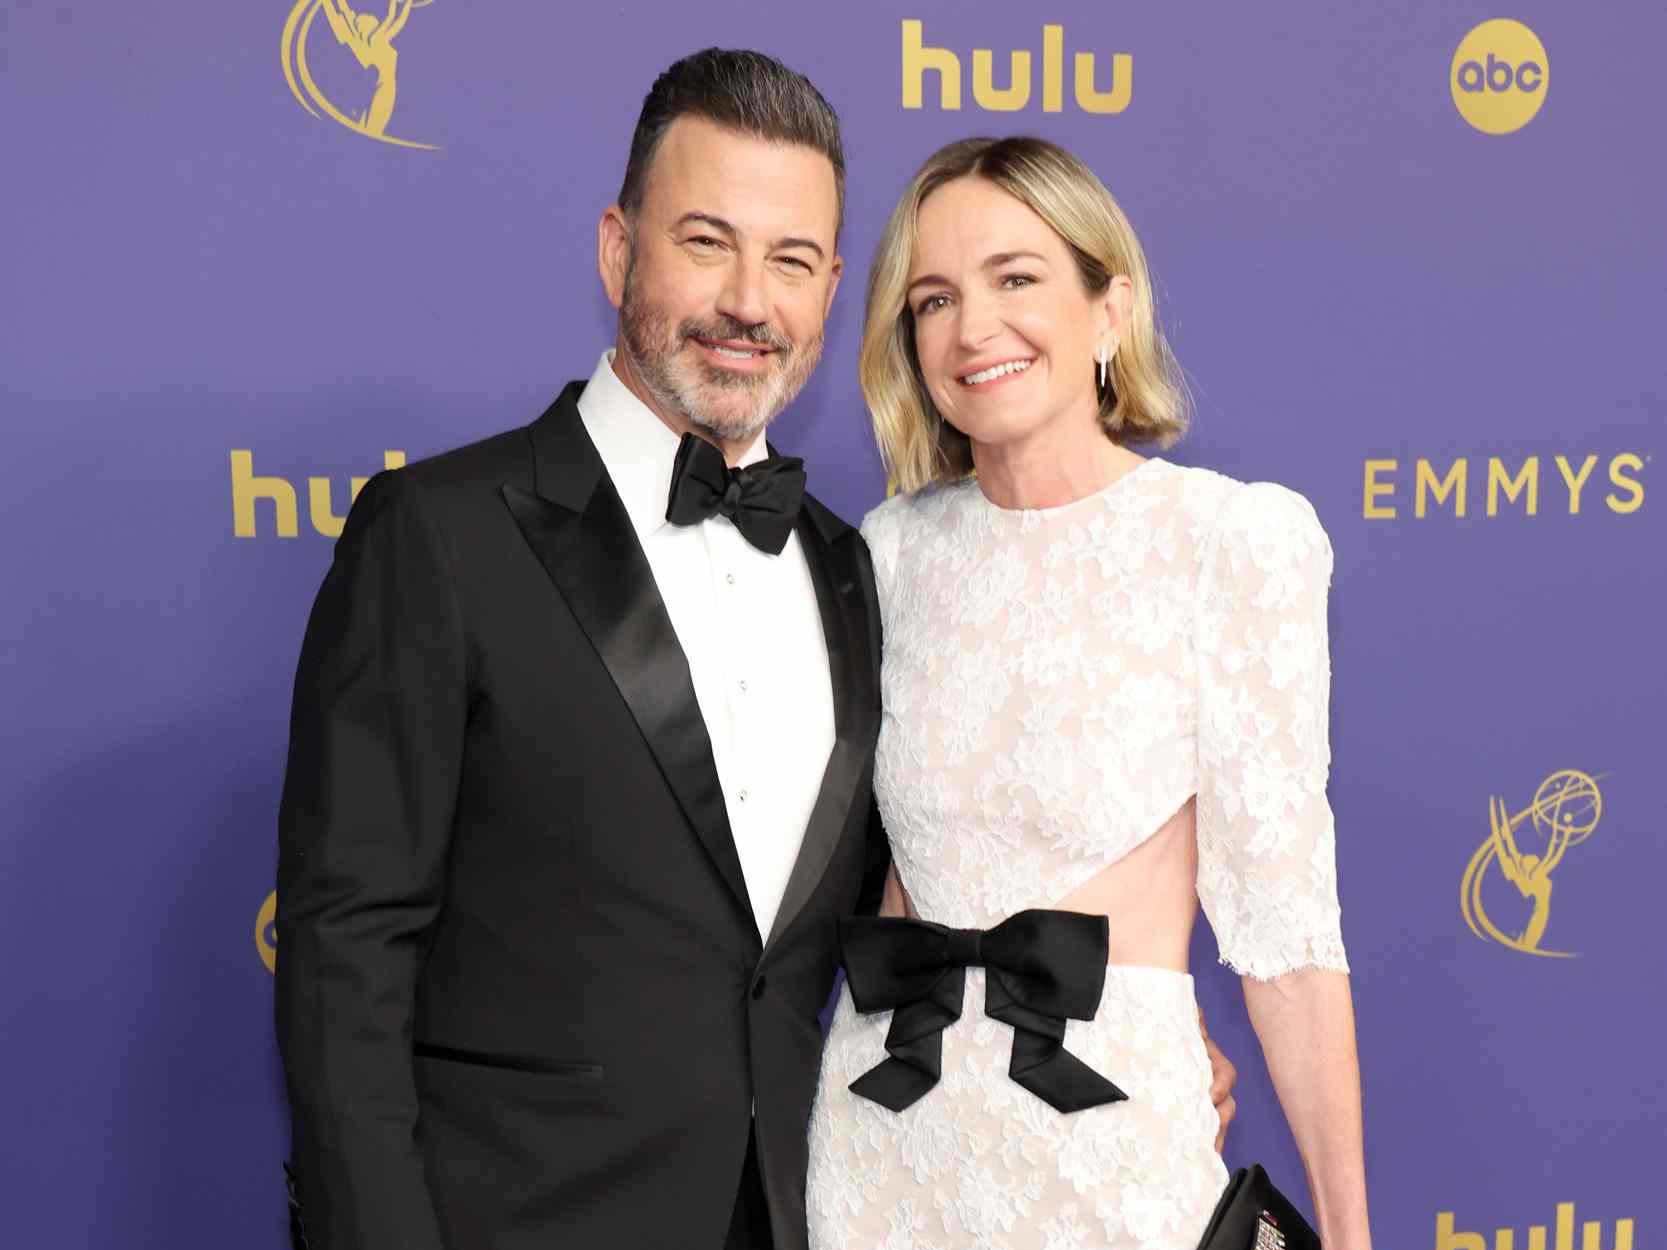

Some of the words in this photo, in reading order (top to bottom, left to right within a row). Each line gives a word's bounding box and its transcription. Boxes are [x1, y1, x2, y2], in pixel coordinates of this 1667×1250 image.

[902, 19, 1133, 113] hulu
[1457, 52, 1542, 93] abc
[230, 449, 406, 537] hu
[1363, 453, 1645, 519] EMMYS
